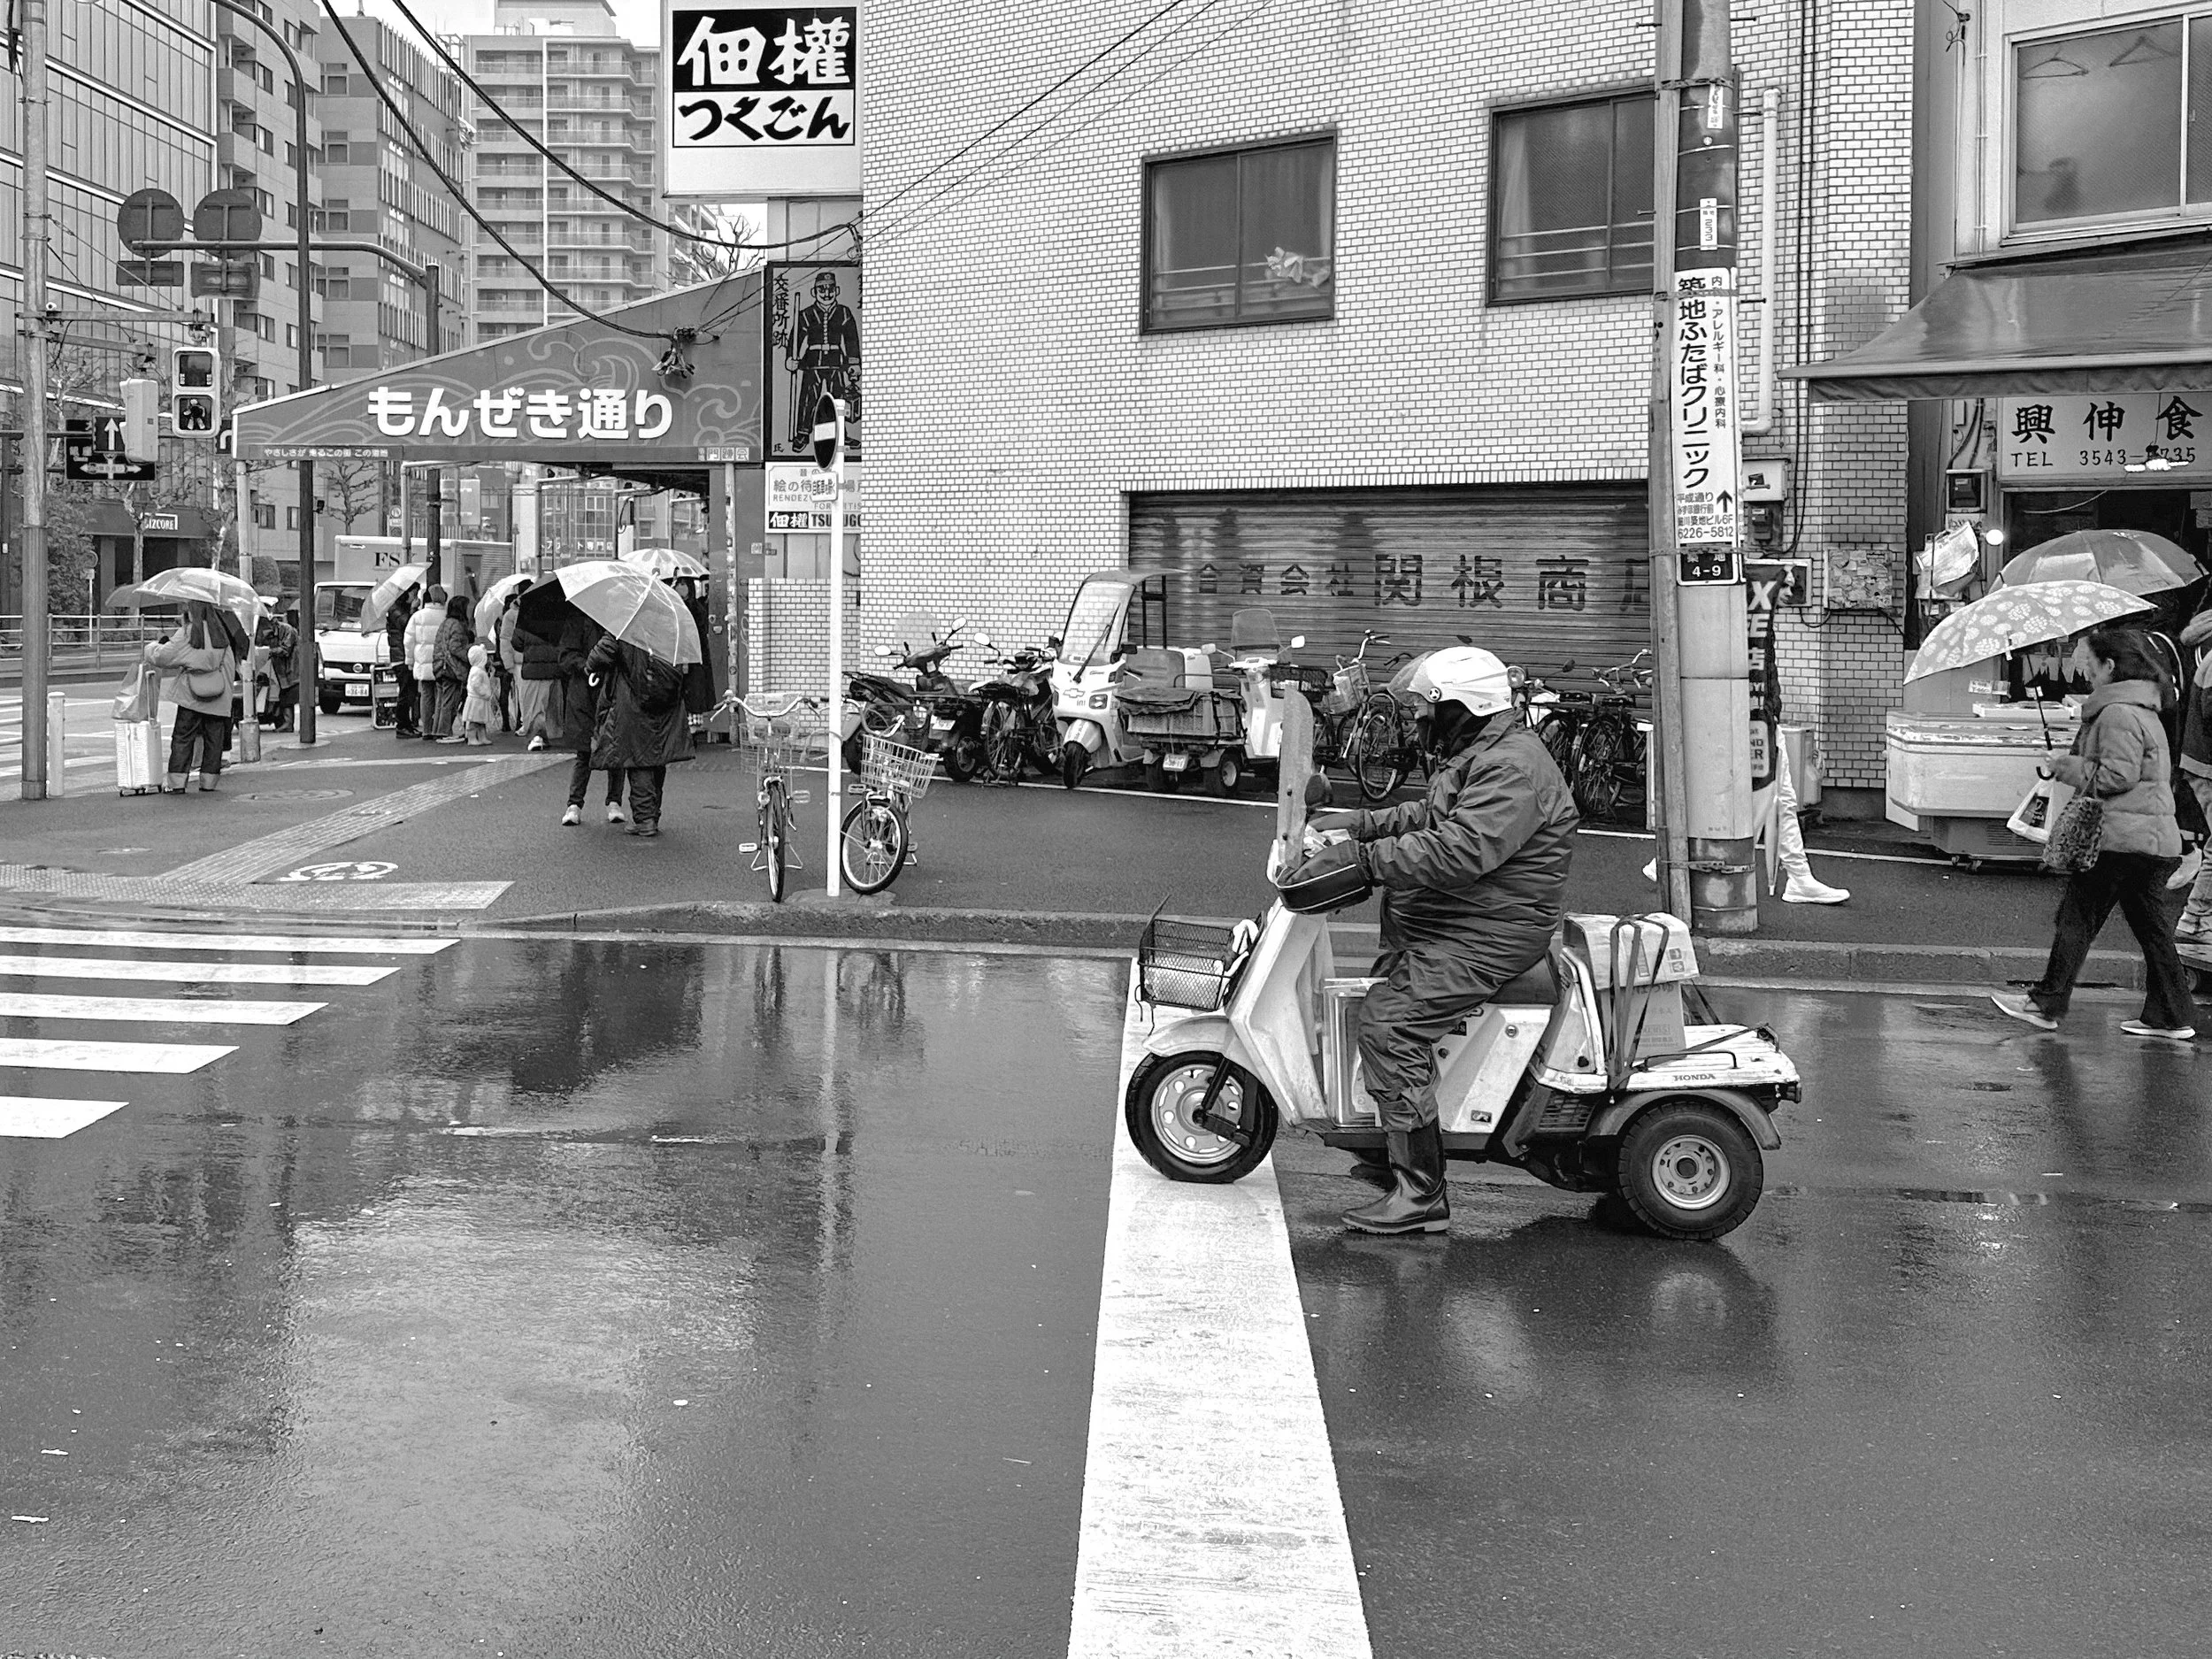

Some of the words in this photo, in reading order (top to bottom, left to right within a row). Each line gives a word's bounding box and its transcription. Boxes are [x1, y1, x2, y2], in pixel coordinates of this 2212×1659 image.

[678, 96, 851, 141] つくごん
[772, 273, 790, 349] 交番所跡
[1711, 276, 1726, 429] 内・アレルギー科・心療内科
[1678, 277, 1709, 488] 築地ふたばクリニック
[367, 386, 672, 440] もんぜき通り
[265, 448, 306, 457] やさしさが
[2011, 451, 2054, 467] TEL
[2080, 448, 2196, 466] 3543-735
[773, 494, 813, 503] RENDEZ
[1678, 526, 1734, 539] 6226-5812
[1692, 565, 1722, 577] 4-9
[1673, 1073, 1716, 1082] HONDA
